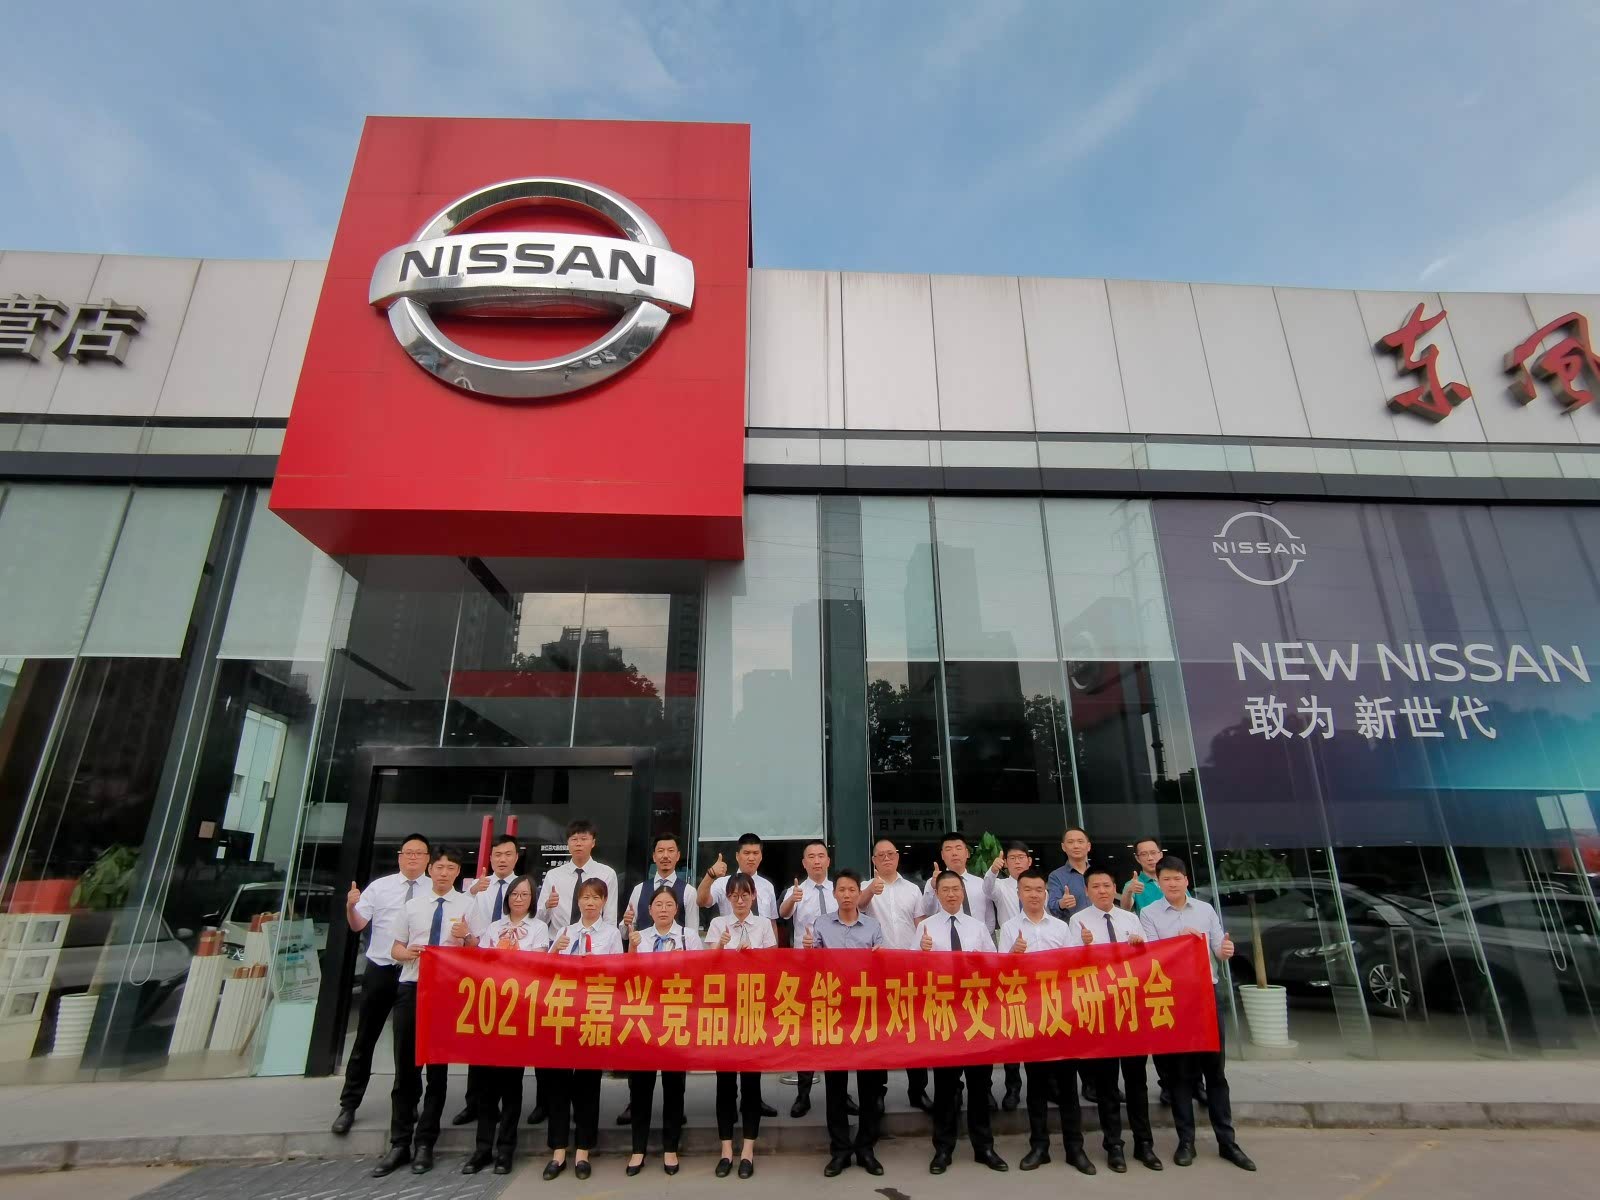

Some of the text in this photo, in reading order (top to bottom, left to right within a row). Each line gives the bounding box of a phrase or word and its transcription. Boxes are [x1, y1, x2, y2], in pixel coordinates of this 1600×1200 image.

[399, 243, 656, 287] NISSAN
[0, 293, 147, 366] 营店
[1375, 303, 1600, 423] 东风
[1212, 541, 1307, 555] NISSAN
[1233, 642, 1591, 683] NEW NISSAN
[1244, 694, 1497, 740] 敢为 新世代
[456, 958, 1176, 1047] 2021年嘉兴竞品服务能力对标交流及研讨会
